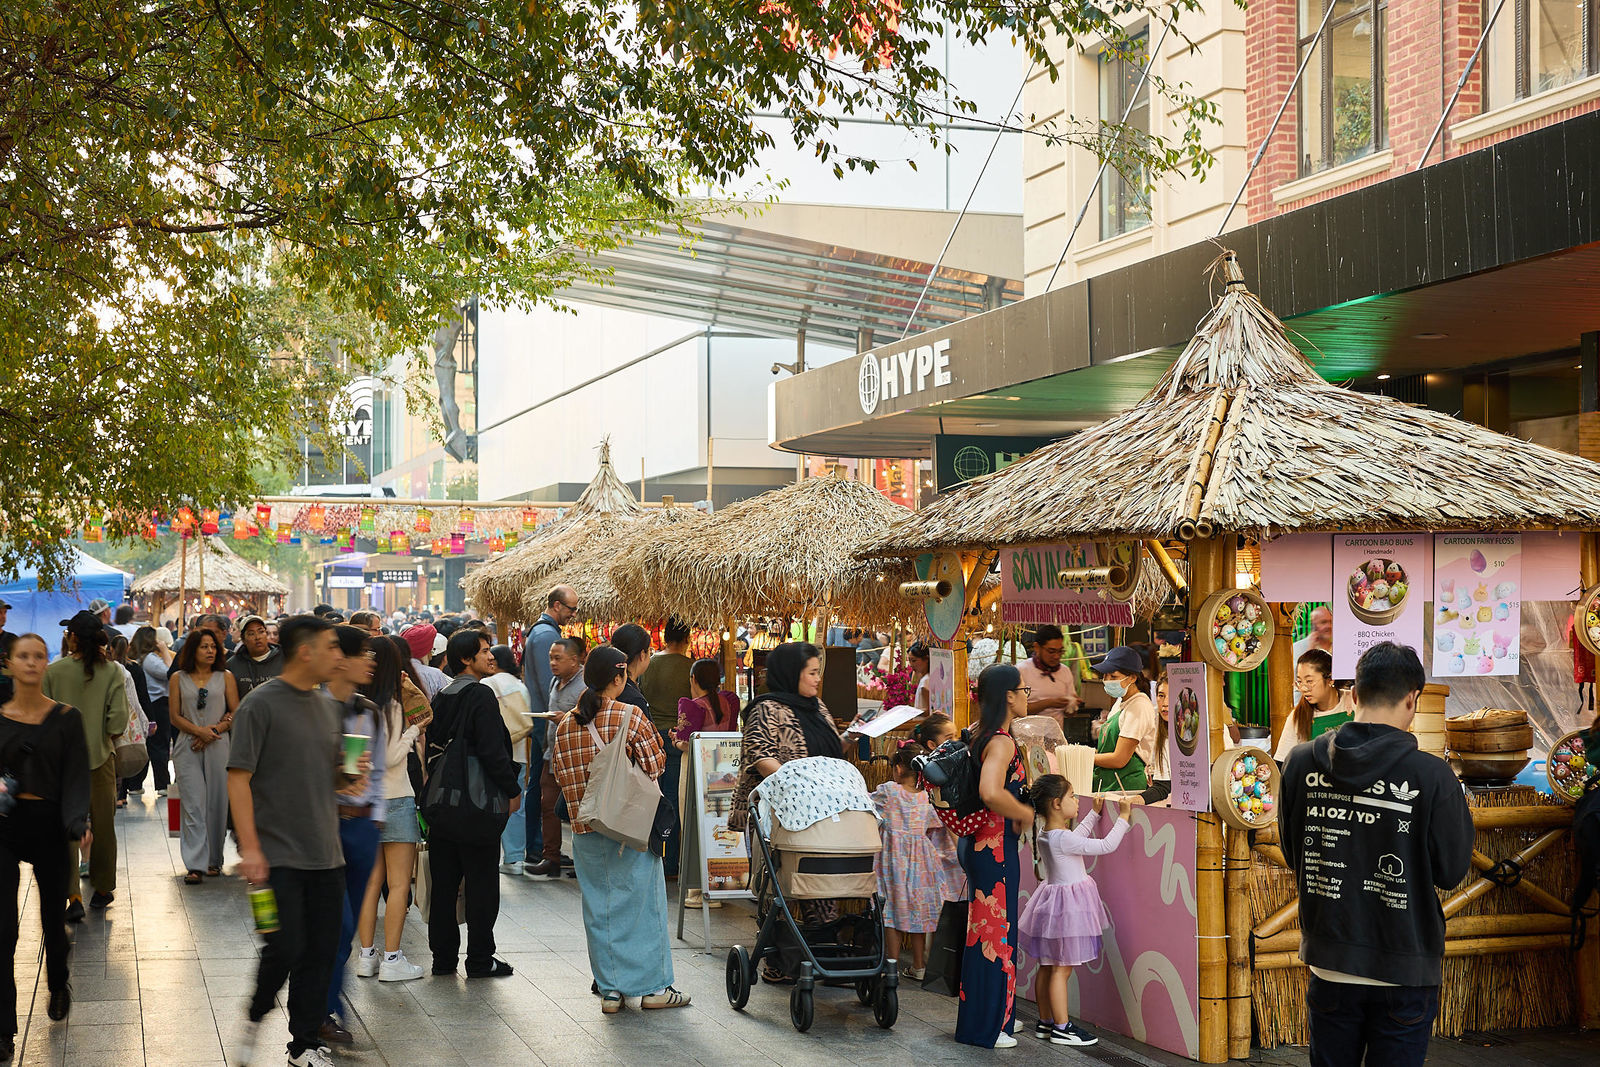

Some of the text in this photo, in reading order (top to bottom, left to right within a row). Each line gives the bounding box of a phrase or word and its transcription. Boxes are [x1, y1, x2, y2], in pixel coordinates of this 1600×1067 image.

[881, 338, 951, 401] HYPE
[1345, 538, 1414, 546] CARTOON BAO BUNS
[1494, 560, 1504, 568] $10
[1002, 602, 1133, 626] CARTOON FAIRY FLOSS & BAO BUNS
[1358, 640, 1369, 648] Egg
[1328, 792, 1351, 802] PURPOSE
[1374, 872, 1394, 882] COTTON
[1331, 878, 1343, 886] Dry
